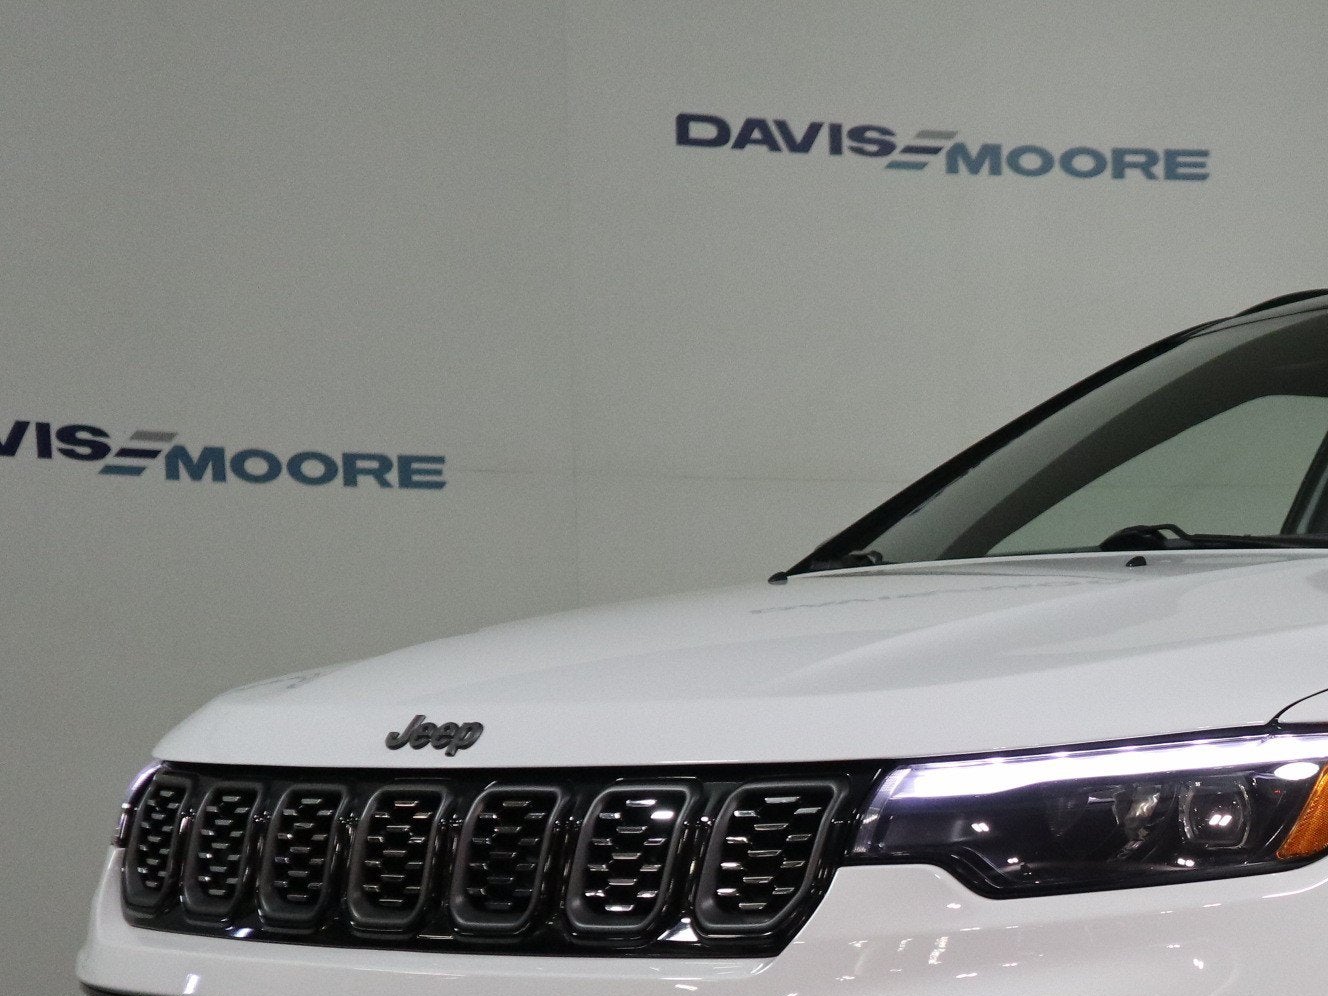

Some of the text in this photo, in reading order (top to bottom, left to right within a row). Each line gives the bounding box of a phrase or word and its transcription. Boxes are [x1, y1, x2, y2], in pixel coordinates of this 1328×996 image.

[675, 112, 1211, 182] DAVIS MOORE
[164, 445, 448, 490] MOORE
[385, 714, 484, 757] Jeep
